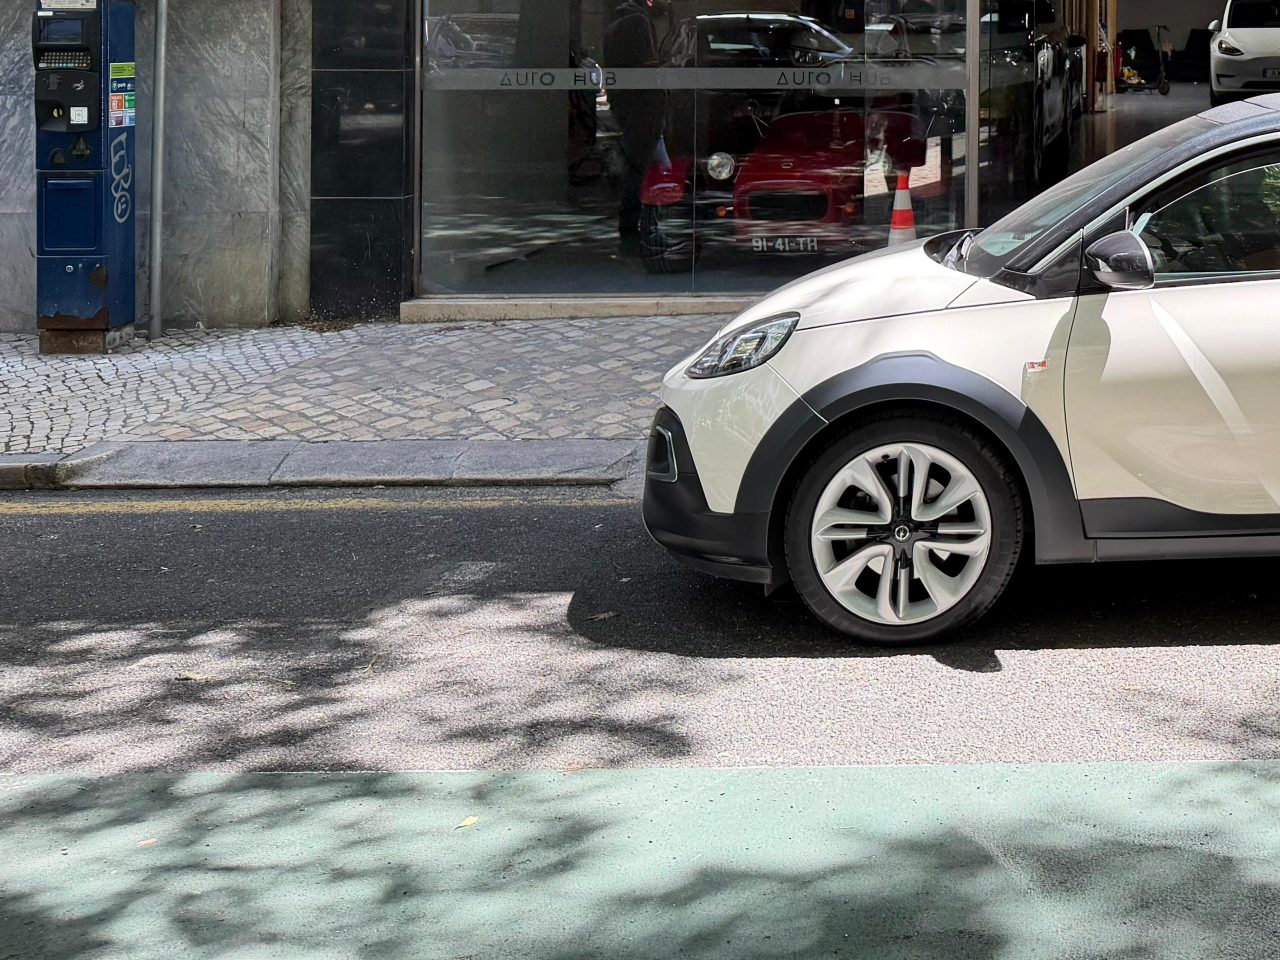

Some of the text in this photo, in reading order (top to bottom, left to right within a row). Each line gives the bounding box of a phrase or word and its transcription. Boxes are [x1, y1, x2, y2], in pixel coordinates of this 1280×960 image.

[500, 72, 616, 86] AUTO HUB
[777, 72, 890, 86] AUTO HUB
[752, 238, 818, 251] 91-41-TH
